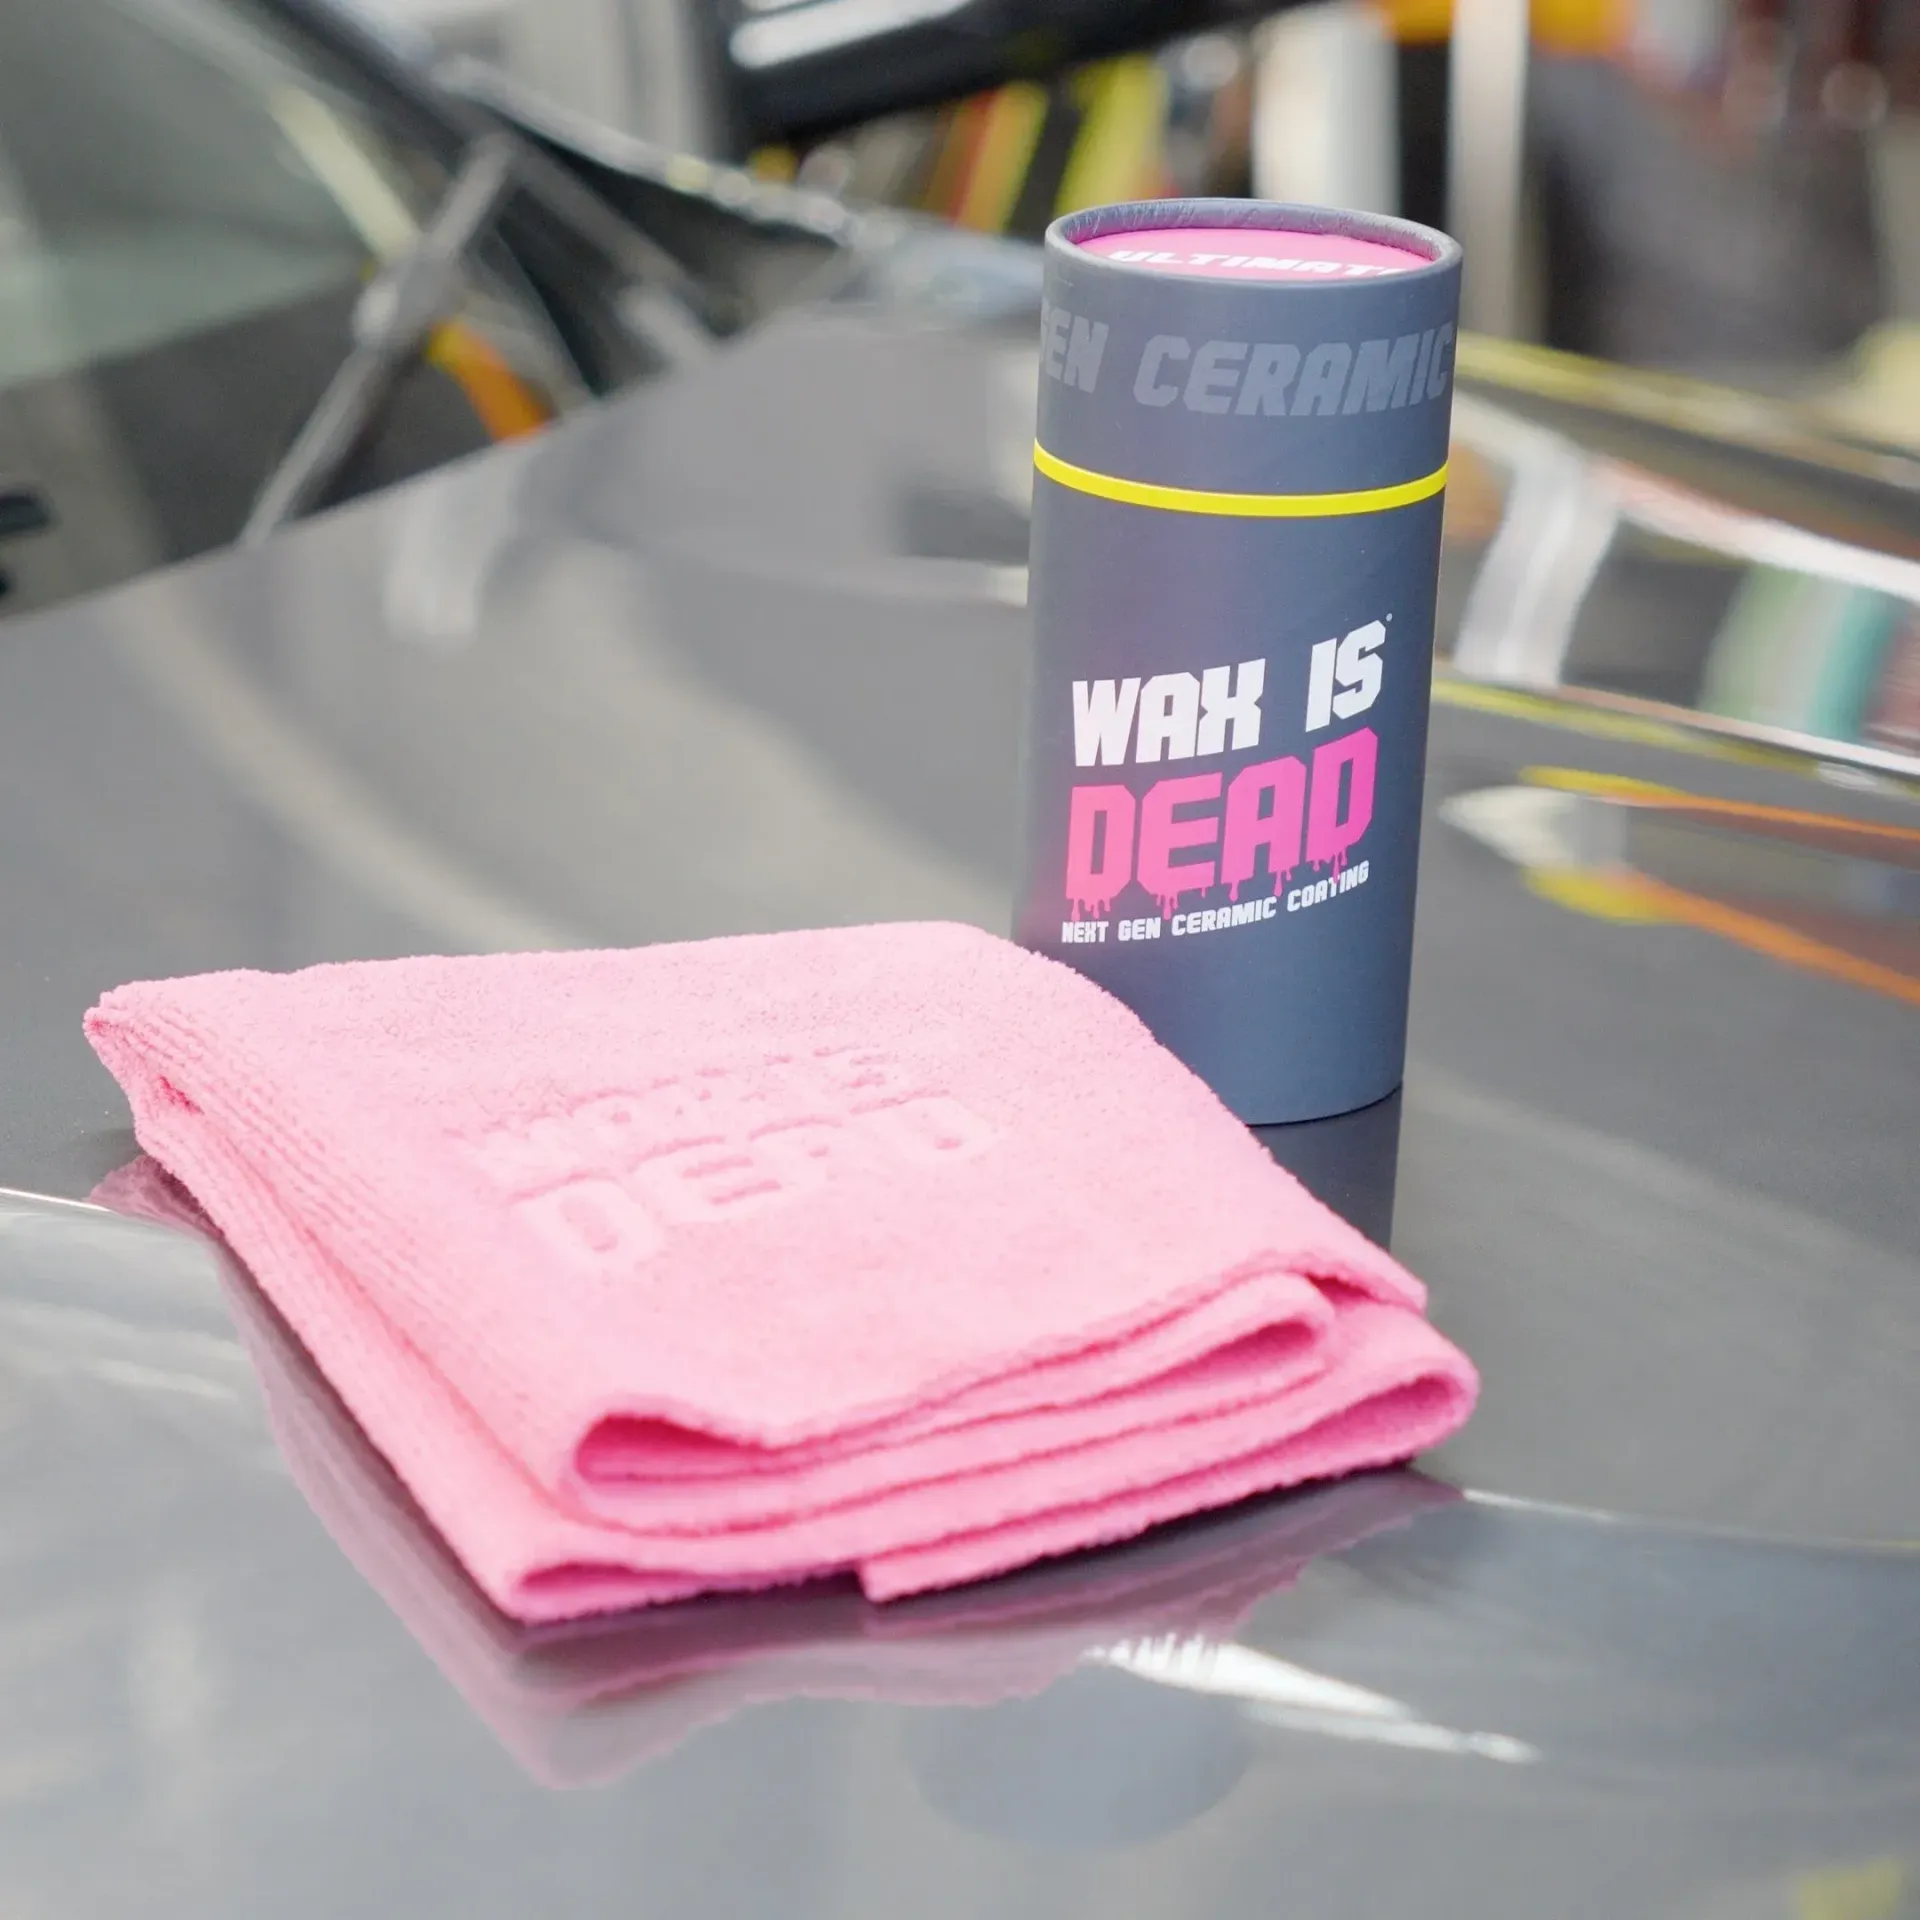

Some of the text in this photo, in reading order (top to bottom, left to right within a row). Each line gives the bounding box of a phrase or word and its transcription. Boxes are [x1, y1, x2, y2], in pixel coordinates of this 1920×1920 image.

[1040, 300, 1454, 417] EN CERAMIC
[1072, 619, 1387, 767] WAX IS
[1065, 726, 1379, 921] DEAD
[1061, 860, 1370, 943] NEXT GEN CERAMIC COATING
